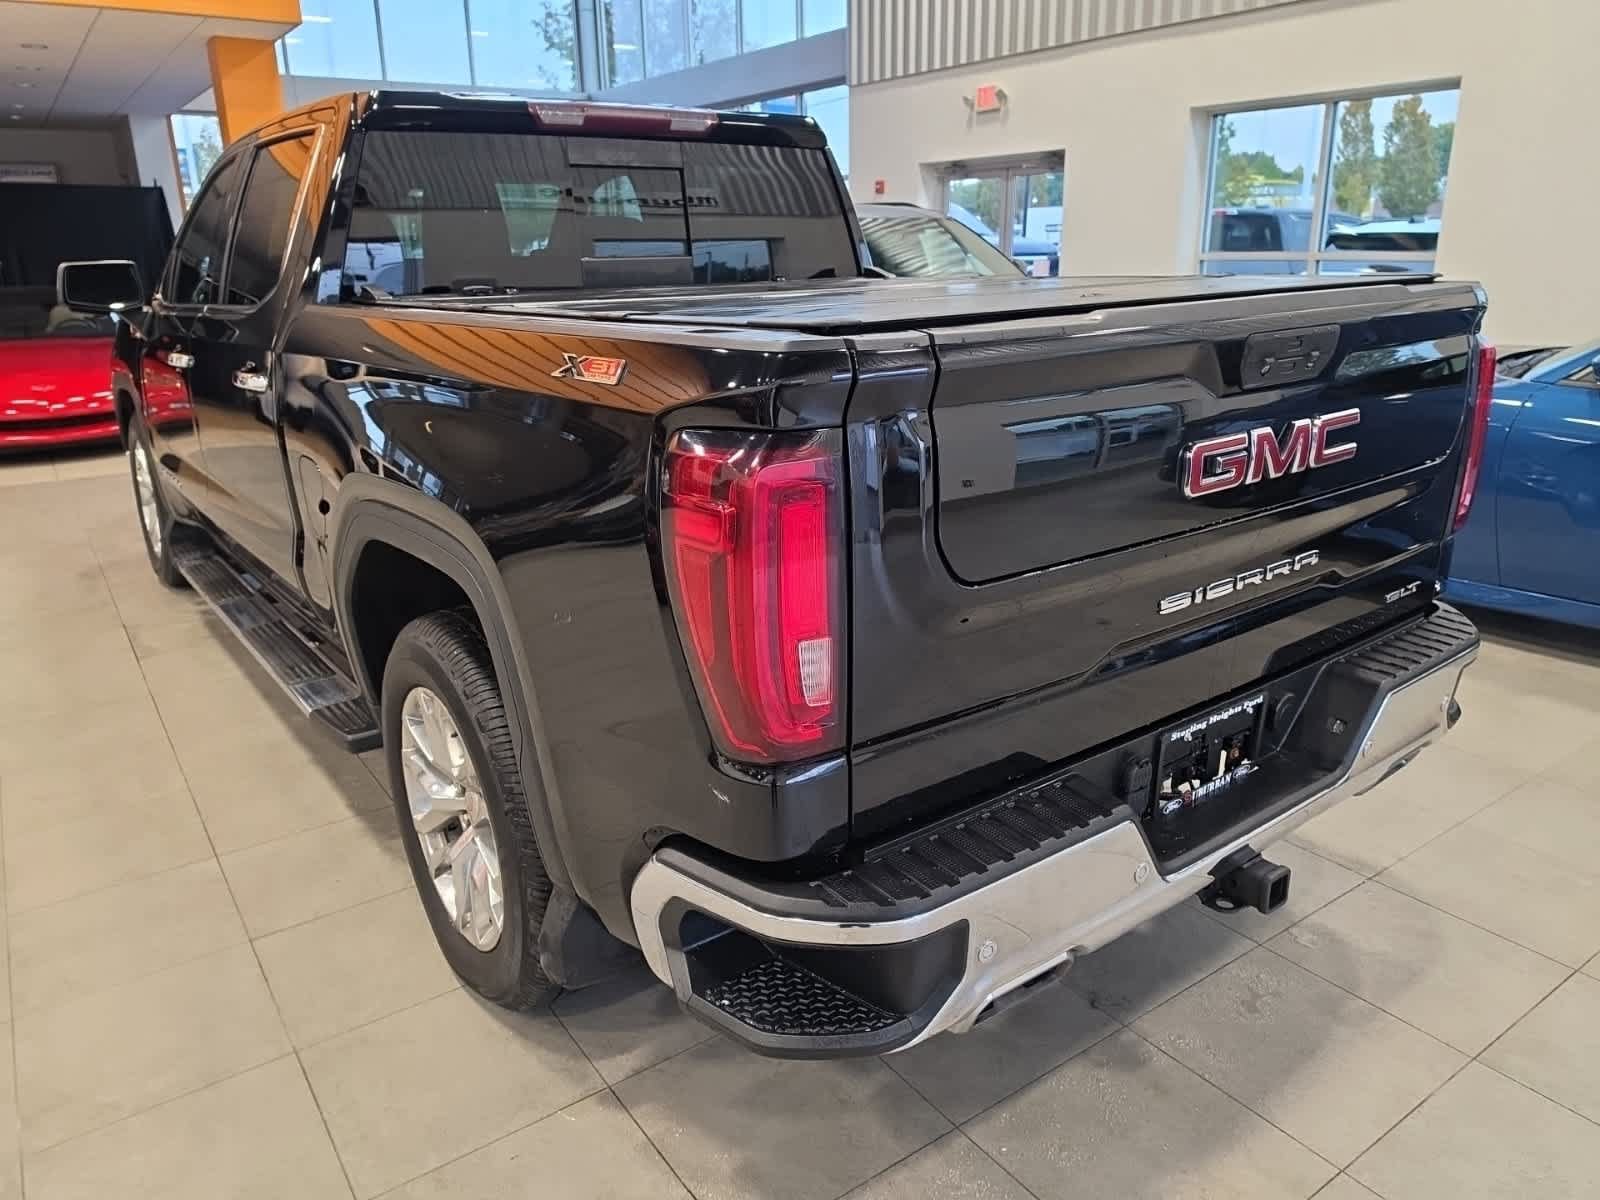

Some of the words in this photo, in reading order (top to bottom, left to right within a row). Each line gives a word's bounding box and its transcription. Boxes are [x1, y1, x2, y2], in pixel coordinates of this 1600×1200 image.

[1183, 407, 1361, 500] GMC
[1159, 549, 1320, 615] SIERRA
[1209, 705, 1242, 724] Heights
